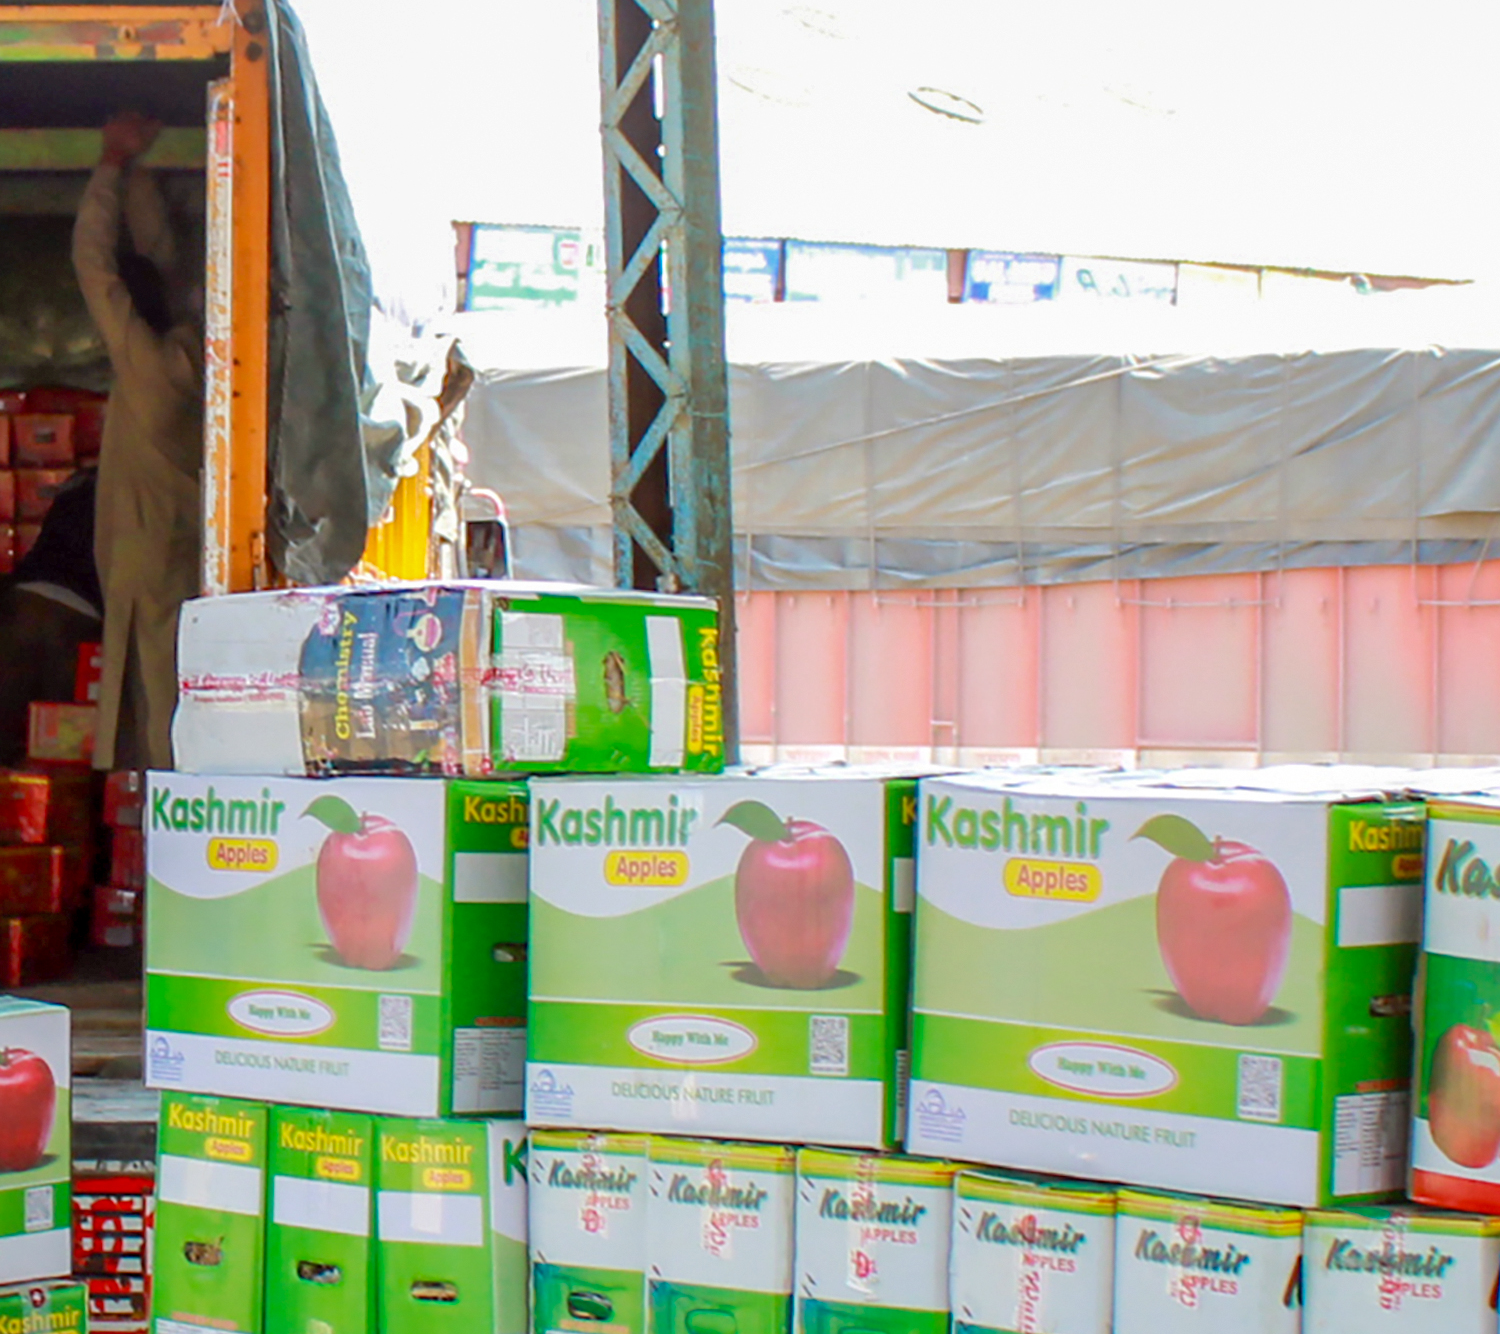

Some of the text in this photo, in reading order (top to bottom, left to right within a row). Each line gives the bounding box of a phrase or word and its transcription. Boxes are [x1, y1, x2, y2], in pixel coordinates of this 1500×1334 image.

[698, 627, 724, 759] Kashmir
[151, 787, 285, 837] Kashmir
[537, 797, 699, 846] Kashmir
[927, 796, 1109, 857] Kashmir
[216, 841, 269, 867] Apples
[616, 854, 679, 880] Apples
[1016, 865, 1088, 893] Apples
[611, 1082, 679, 1101] DELICIOUS
[738, 1090, 774, 1105] FRUIT
[168, 1101, 254, 1136] Kashmir
[1009, 1108, 1196, 1149] DELICIOUS NATURE FRUIT
[279, 1122, 362, 1157] Kashmir
[381, 1135, 472, 1166] Kashmir
[428, 1169, 469, 1190] Apples
